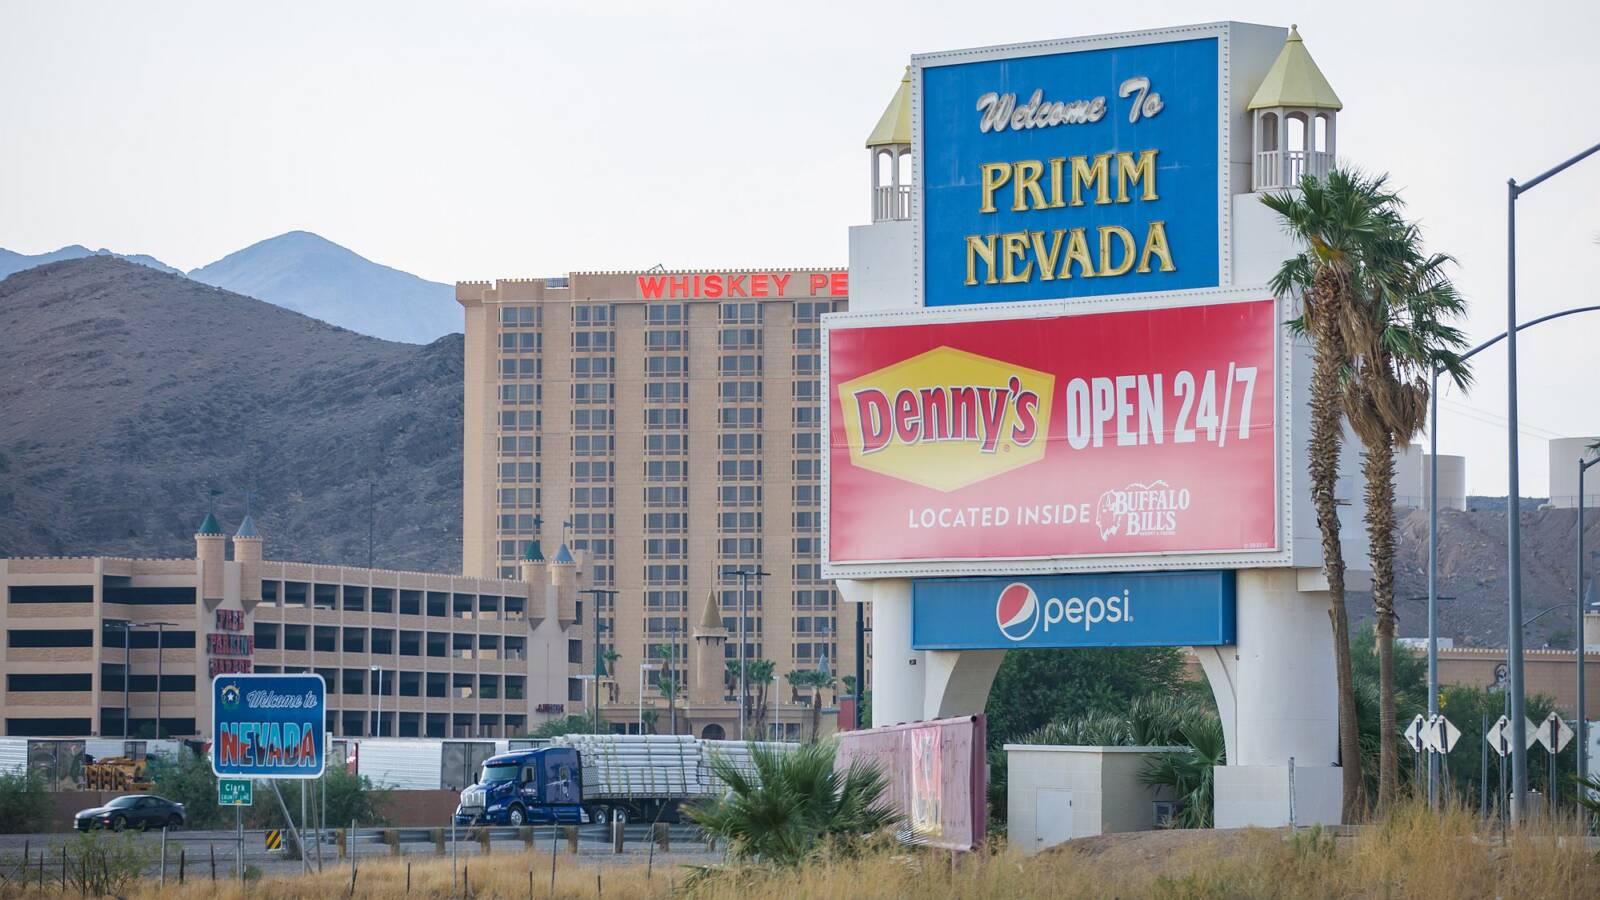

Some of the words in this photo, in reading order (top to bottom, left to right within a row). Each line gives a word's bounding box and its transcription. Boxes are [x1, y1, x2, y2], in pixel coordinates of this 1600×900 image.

[976, 89, 1107, 134] Welcome
[1119, 76, 1164, 124] To
[979, 148, 1159, 214] PRIMM
[963, 220, 1177, 286] NEVADA
[638, 273, 792, 299] WHISKEY
[853, 376, 1040, 455] Denny's
[1066, 370, 1164, 450] OPEN
[1173, 361, 1258, 448] 24/7
[908, 506, 1010, 529] LOCATED
[1017, 503, 1091, 526] INSIDE
[1113, 488, 1190, 515] BUFFALO
[1044, 589, 1130, 632] pepsi
[246, 690, 303, 708] Welcome
[303, 690, 318, 708] to
[219, 721, 317, 768] NEVADA
